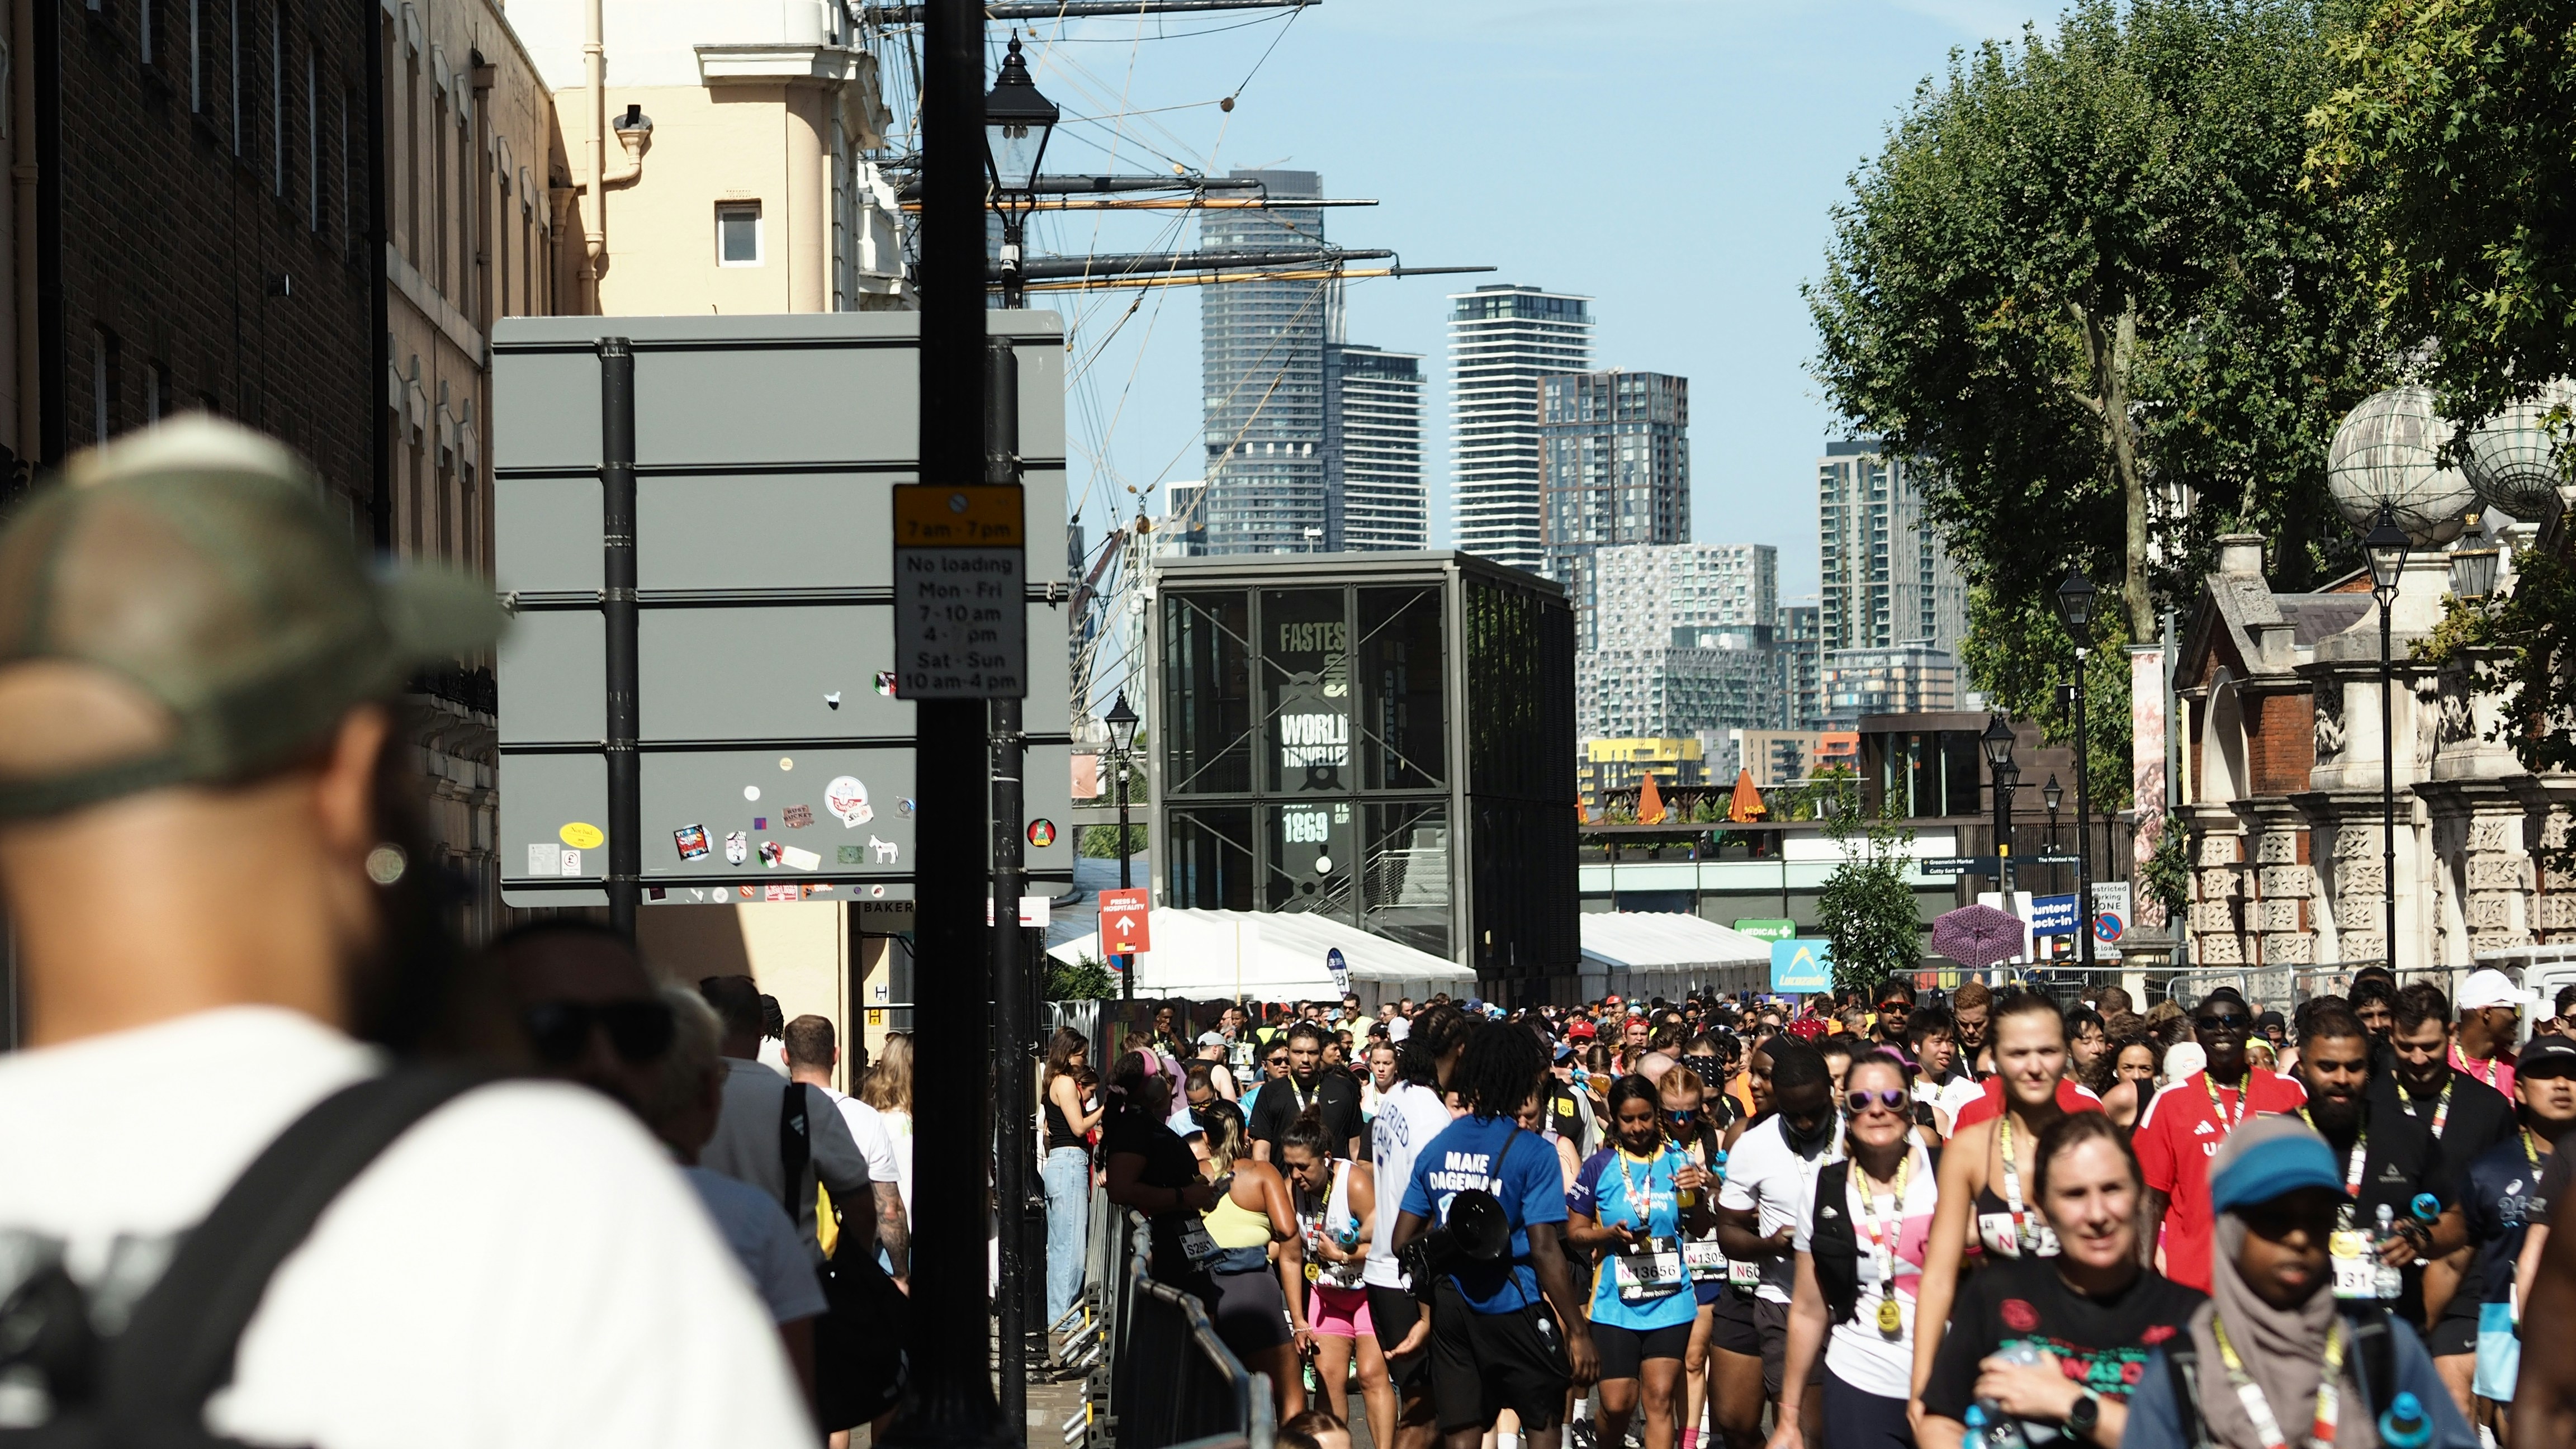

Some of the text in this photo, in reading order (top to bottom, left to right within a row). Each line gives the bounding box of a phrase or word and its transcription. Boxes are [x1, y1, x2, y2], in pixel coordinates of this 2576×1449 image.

[907, 556, 1014, 576] No loading
[918, 582, 960, 599] Mon
[976, 581, 1003, 599] Fri
[1280, 622, 1346, 652] FASTES
[917, 652, 950, 669] Sat
[967, 652, 1006, 669] Sun
[1281, 713, 1348, 745] WORLD
[1282, 812, 1328, 842] 1869
[864, 902, 913, 912] BAKER
[1104, 903, 1145, 912] HOSPITALITY
[2032, 903, 2072, 915] lunteer
[2099, 902, 2122, 910] ONE
[1740, 927, 1778, 936] MEDICAL
[1779, 974, 1826, 986] Lucozade
[1445, 1151, 1490, 1174] MAKE
[1429, 1171, 1503, 1197] DAGENHAM
[1621, 1265, 1676, 1280] N13656
